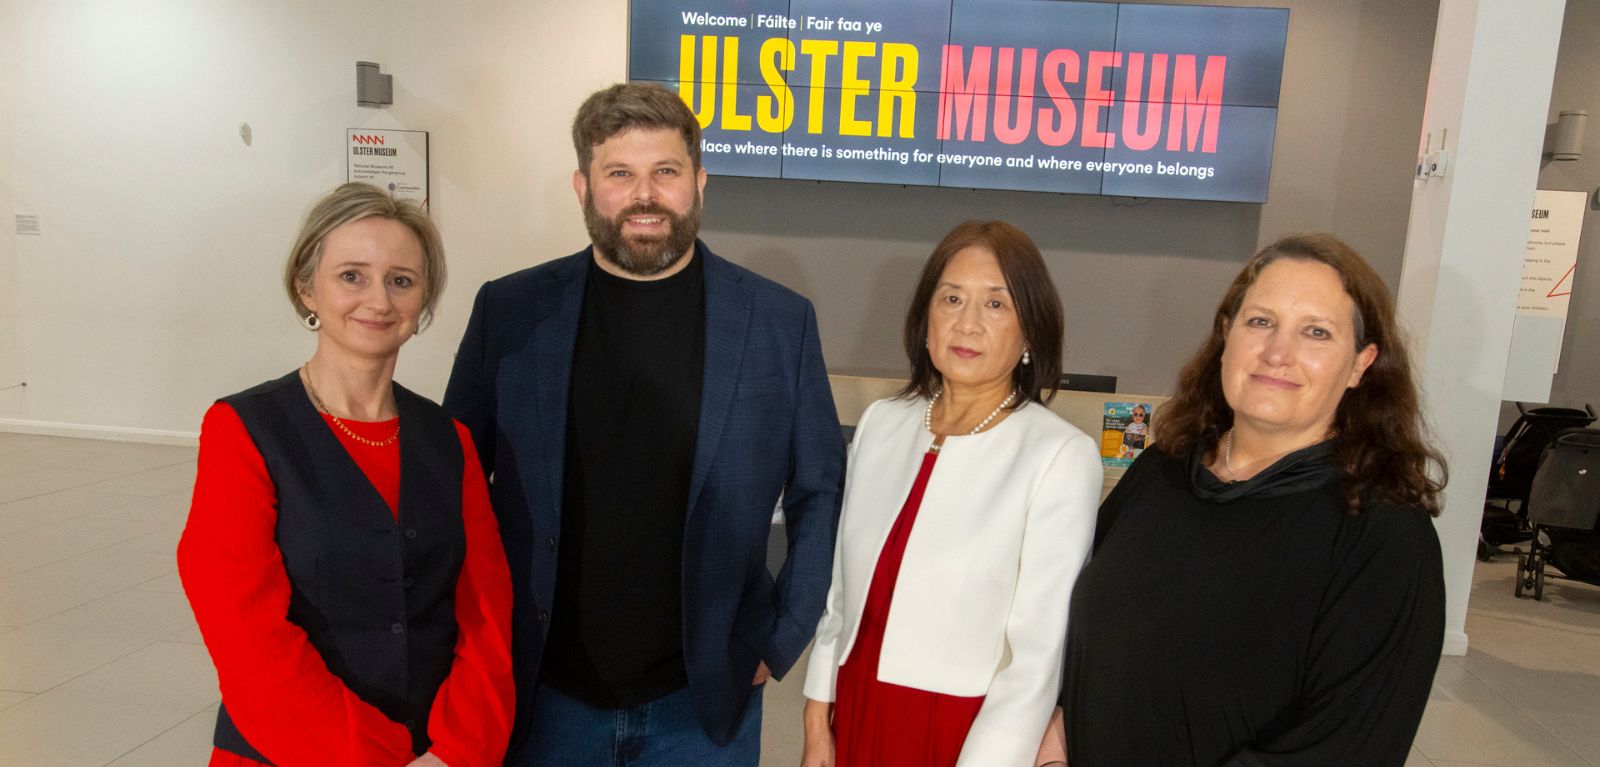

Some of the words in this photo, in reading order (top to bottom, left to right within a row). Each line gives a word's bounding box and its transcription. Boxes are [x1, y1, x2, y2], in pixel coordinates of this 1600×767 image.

[682, 12, 747, 27] Welcome
[758, 14, 797, 29] Fáilte
[807, 16, 834, 31] Fair
[838, 17, 862, 32] faa
[866, 20, 882, 35] ye
[678, 34, 919, 139] ULSTER
[936, 44, 1227, 153] MUSEUM
[353, 146, 373, 156] ULSTER
[374, 148, 397, 157] MUSEUM
[700, 139, 732, 153] lace
[735, 141, 778, 156] where
[781, 143, 818, 158] there
[822, 145, 833, 158] is
[836, 146, 909, 165] something
[913, 149, 932, 163] for
[936, 153, 1002, 168] everyone
[1006, 155, 1034, 168] and
[1038, 156, 1082, 171] where
[1086, 160, 1153, 176] everyone
[1157, 161, 1215, 180] belongs
